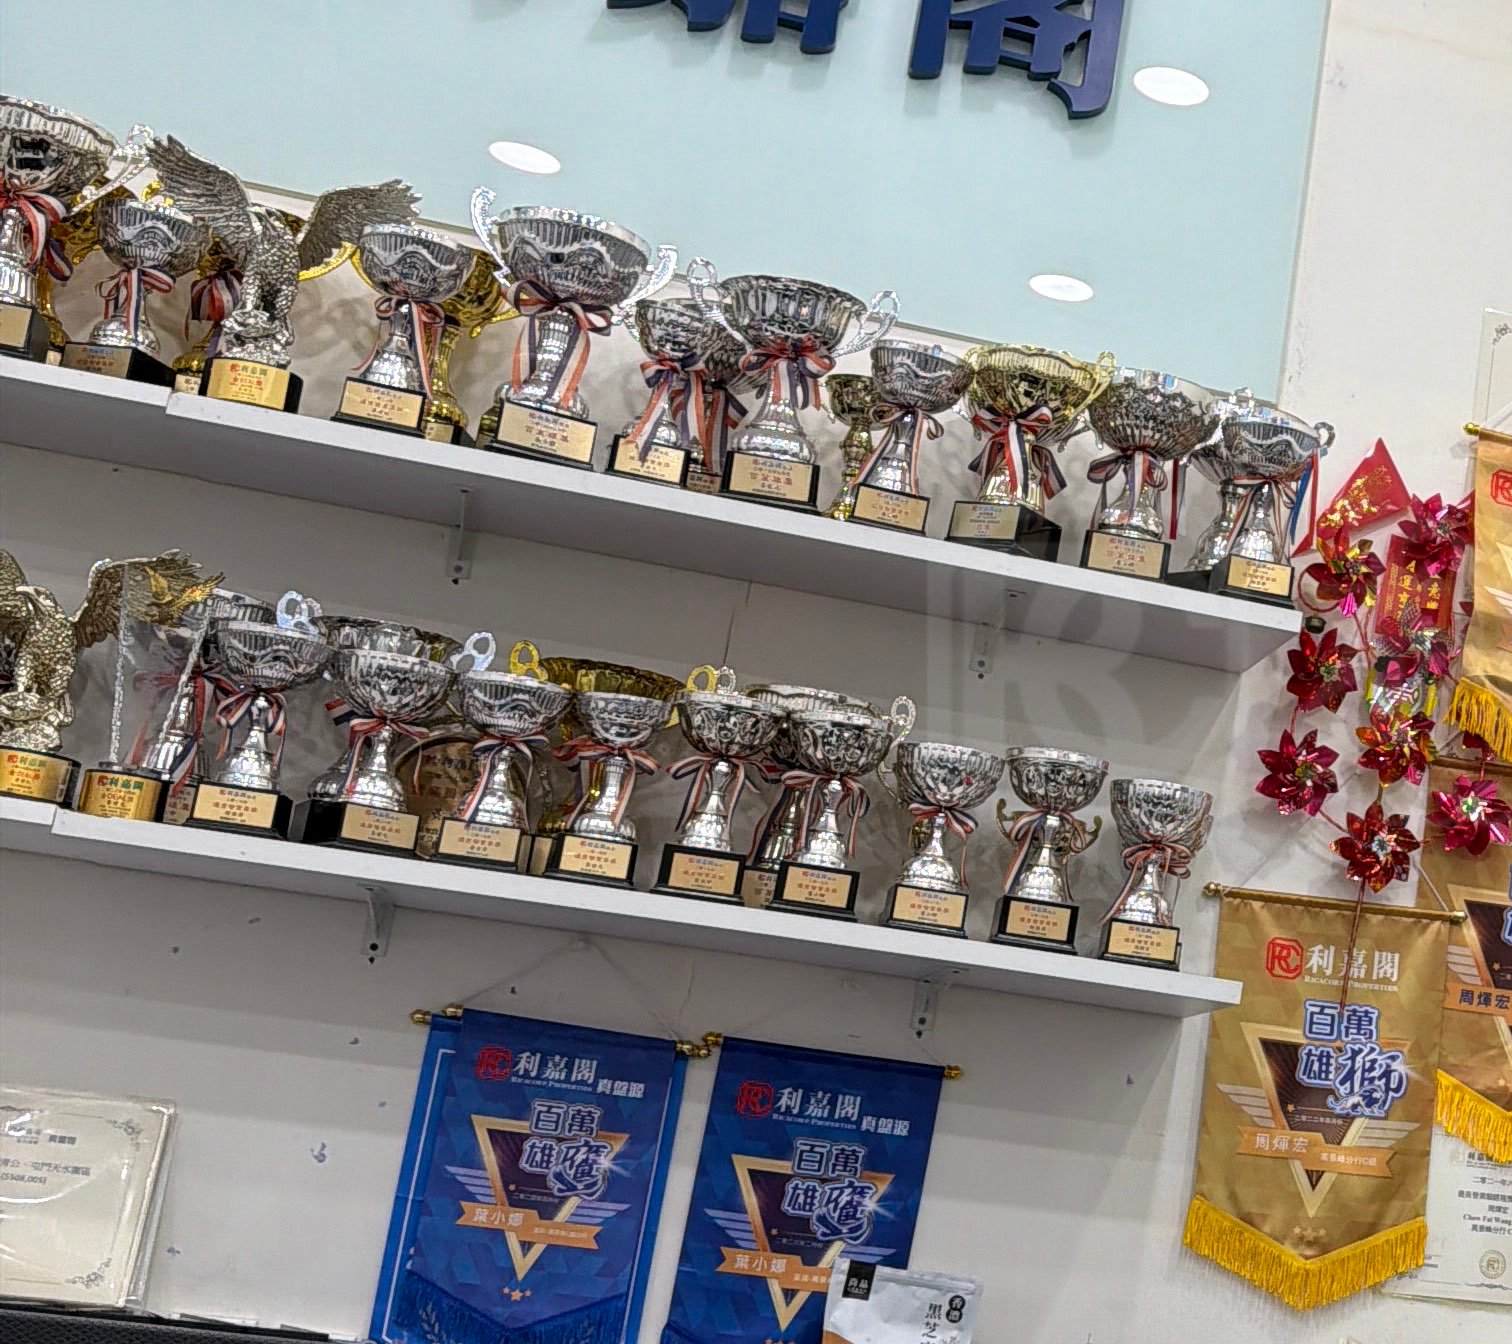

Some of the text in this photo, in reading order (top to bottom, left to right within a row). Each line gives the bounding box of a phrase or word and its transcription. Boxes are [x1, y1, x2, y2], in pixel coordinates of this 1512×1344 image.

[1306, 944, 1400, 983] 利嘉閣
[1305, 1000, 1379, 1041] 百萬
[513, 1051, 598, 1084] 利嘉閣
[597, 1079, 645, 1098] 真盤源
[776, 1088, 862, 1121] 利嘉閣
[531, 1100, 601, 1137] 百萬
[861, 1116, 910, 1136] 真盤源
[794, 1139, 866, 1177] 百萬
[1483, 1215, 1493, 1223] Fai
